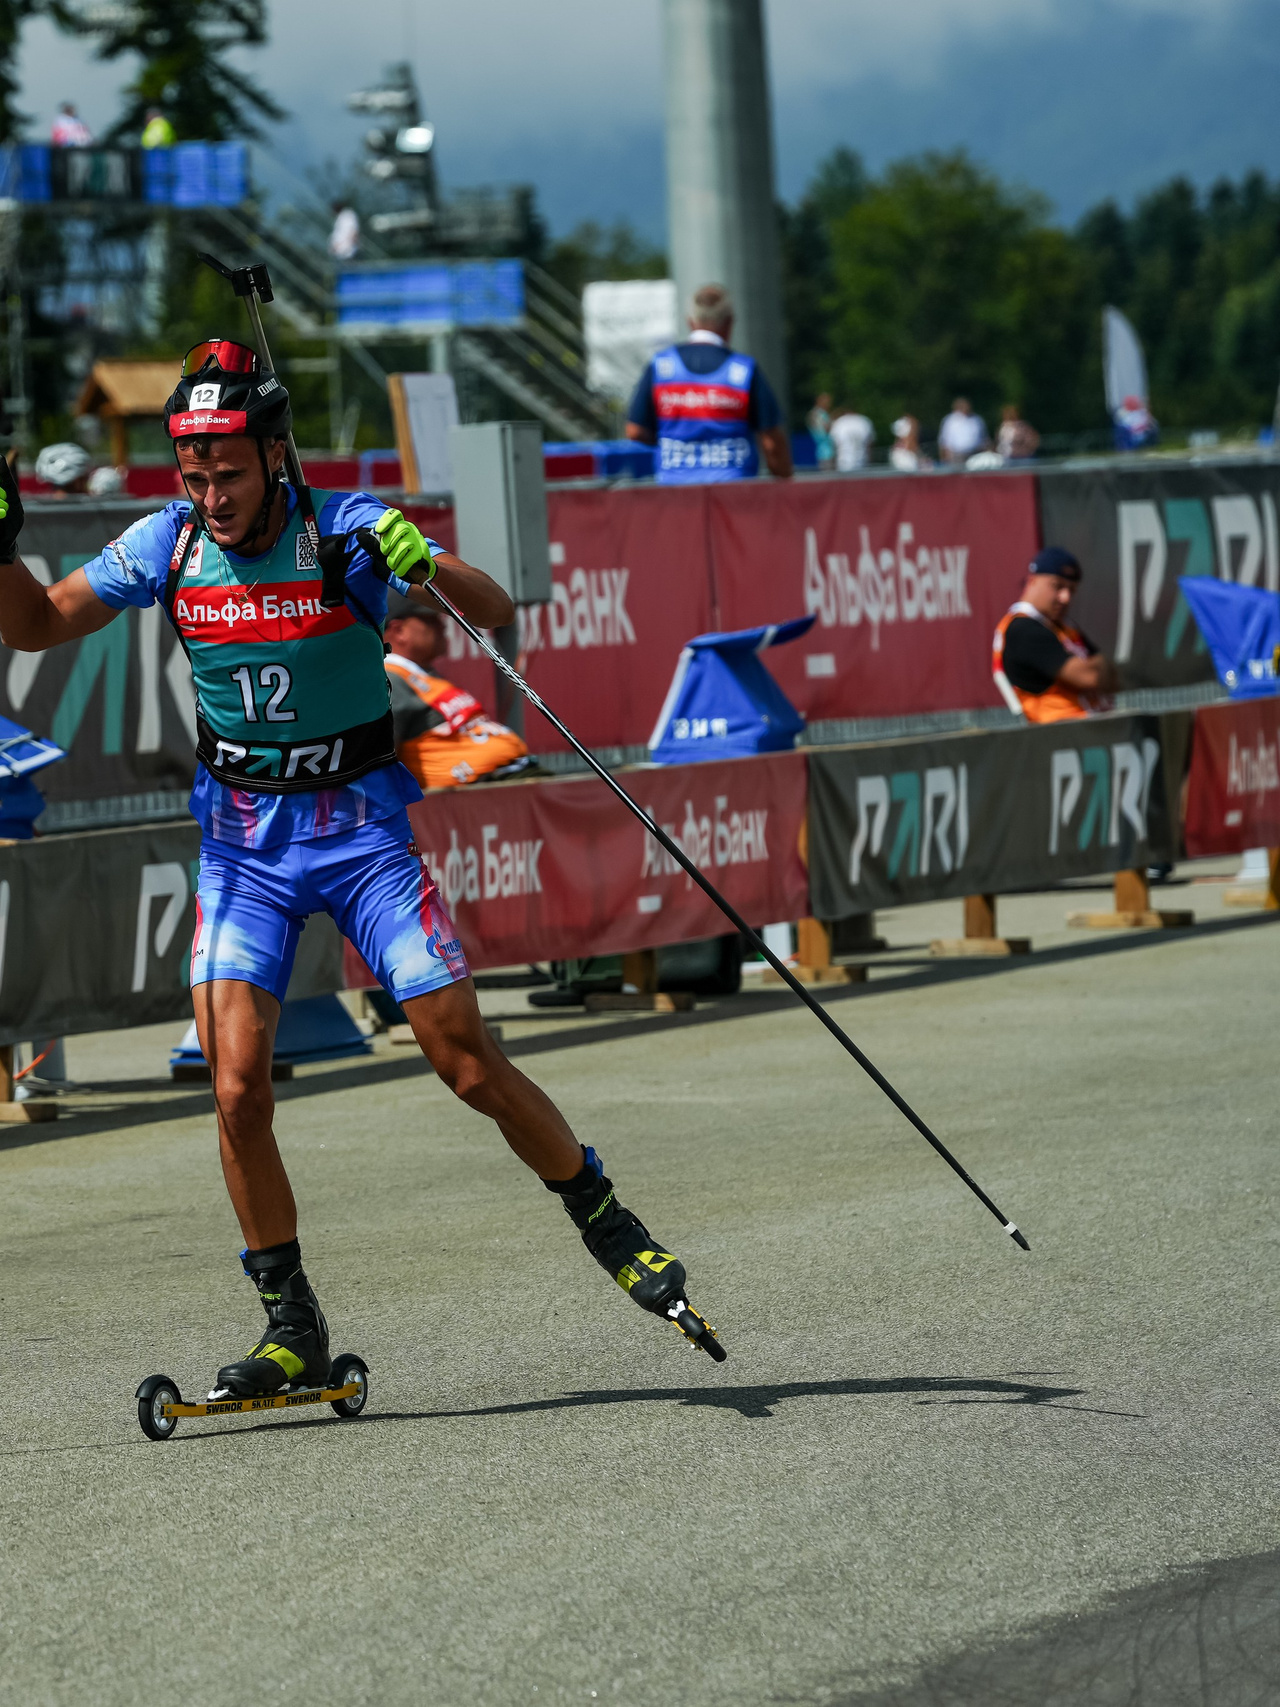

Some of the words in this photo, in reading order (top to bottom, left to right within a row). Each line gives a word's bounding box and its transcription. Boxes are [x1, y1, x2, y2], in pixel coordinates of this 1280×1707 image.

[180, 415, 205, 426] Альфа
[207, 415, 230, 424] Банк
[195, 389, 214, 403] 12
[177, 598, 257, 627] Альфа
[804, 524, 897, 652] Альфа
[897, 522, 971, 621] Банк
[230, 664, 297, 722] 12
[213, 738, 343, 778] PARI
[849, 762, 969, 886] PARI
[1048, 737, 1160, 856] PARI
[714, 795, 769, 867] Банк
[482, 826, 544, 900] Банк
[206, 1401, 243, 1414] SWENOR
[251, 1398, 275, 1409] SKATE
[285, 1392, 321, 1405] SWENOR
